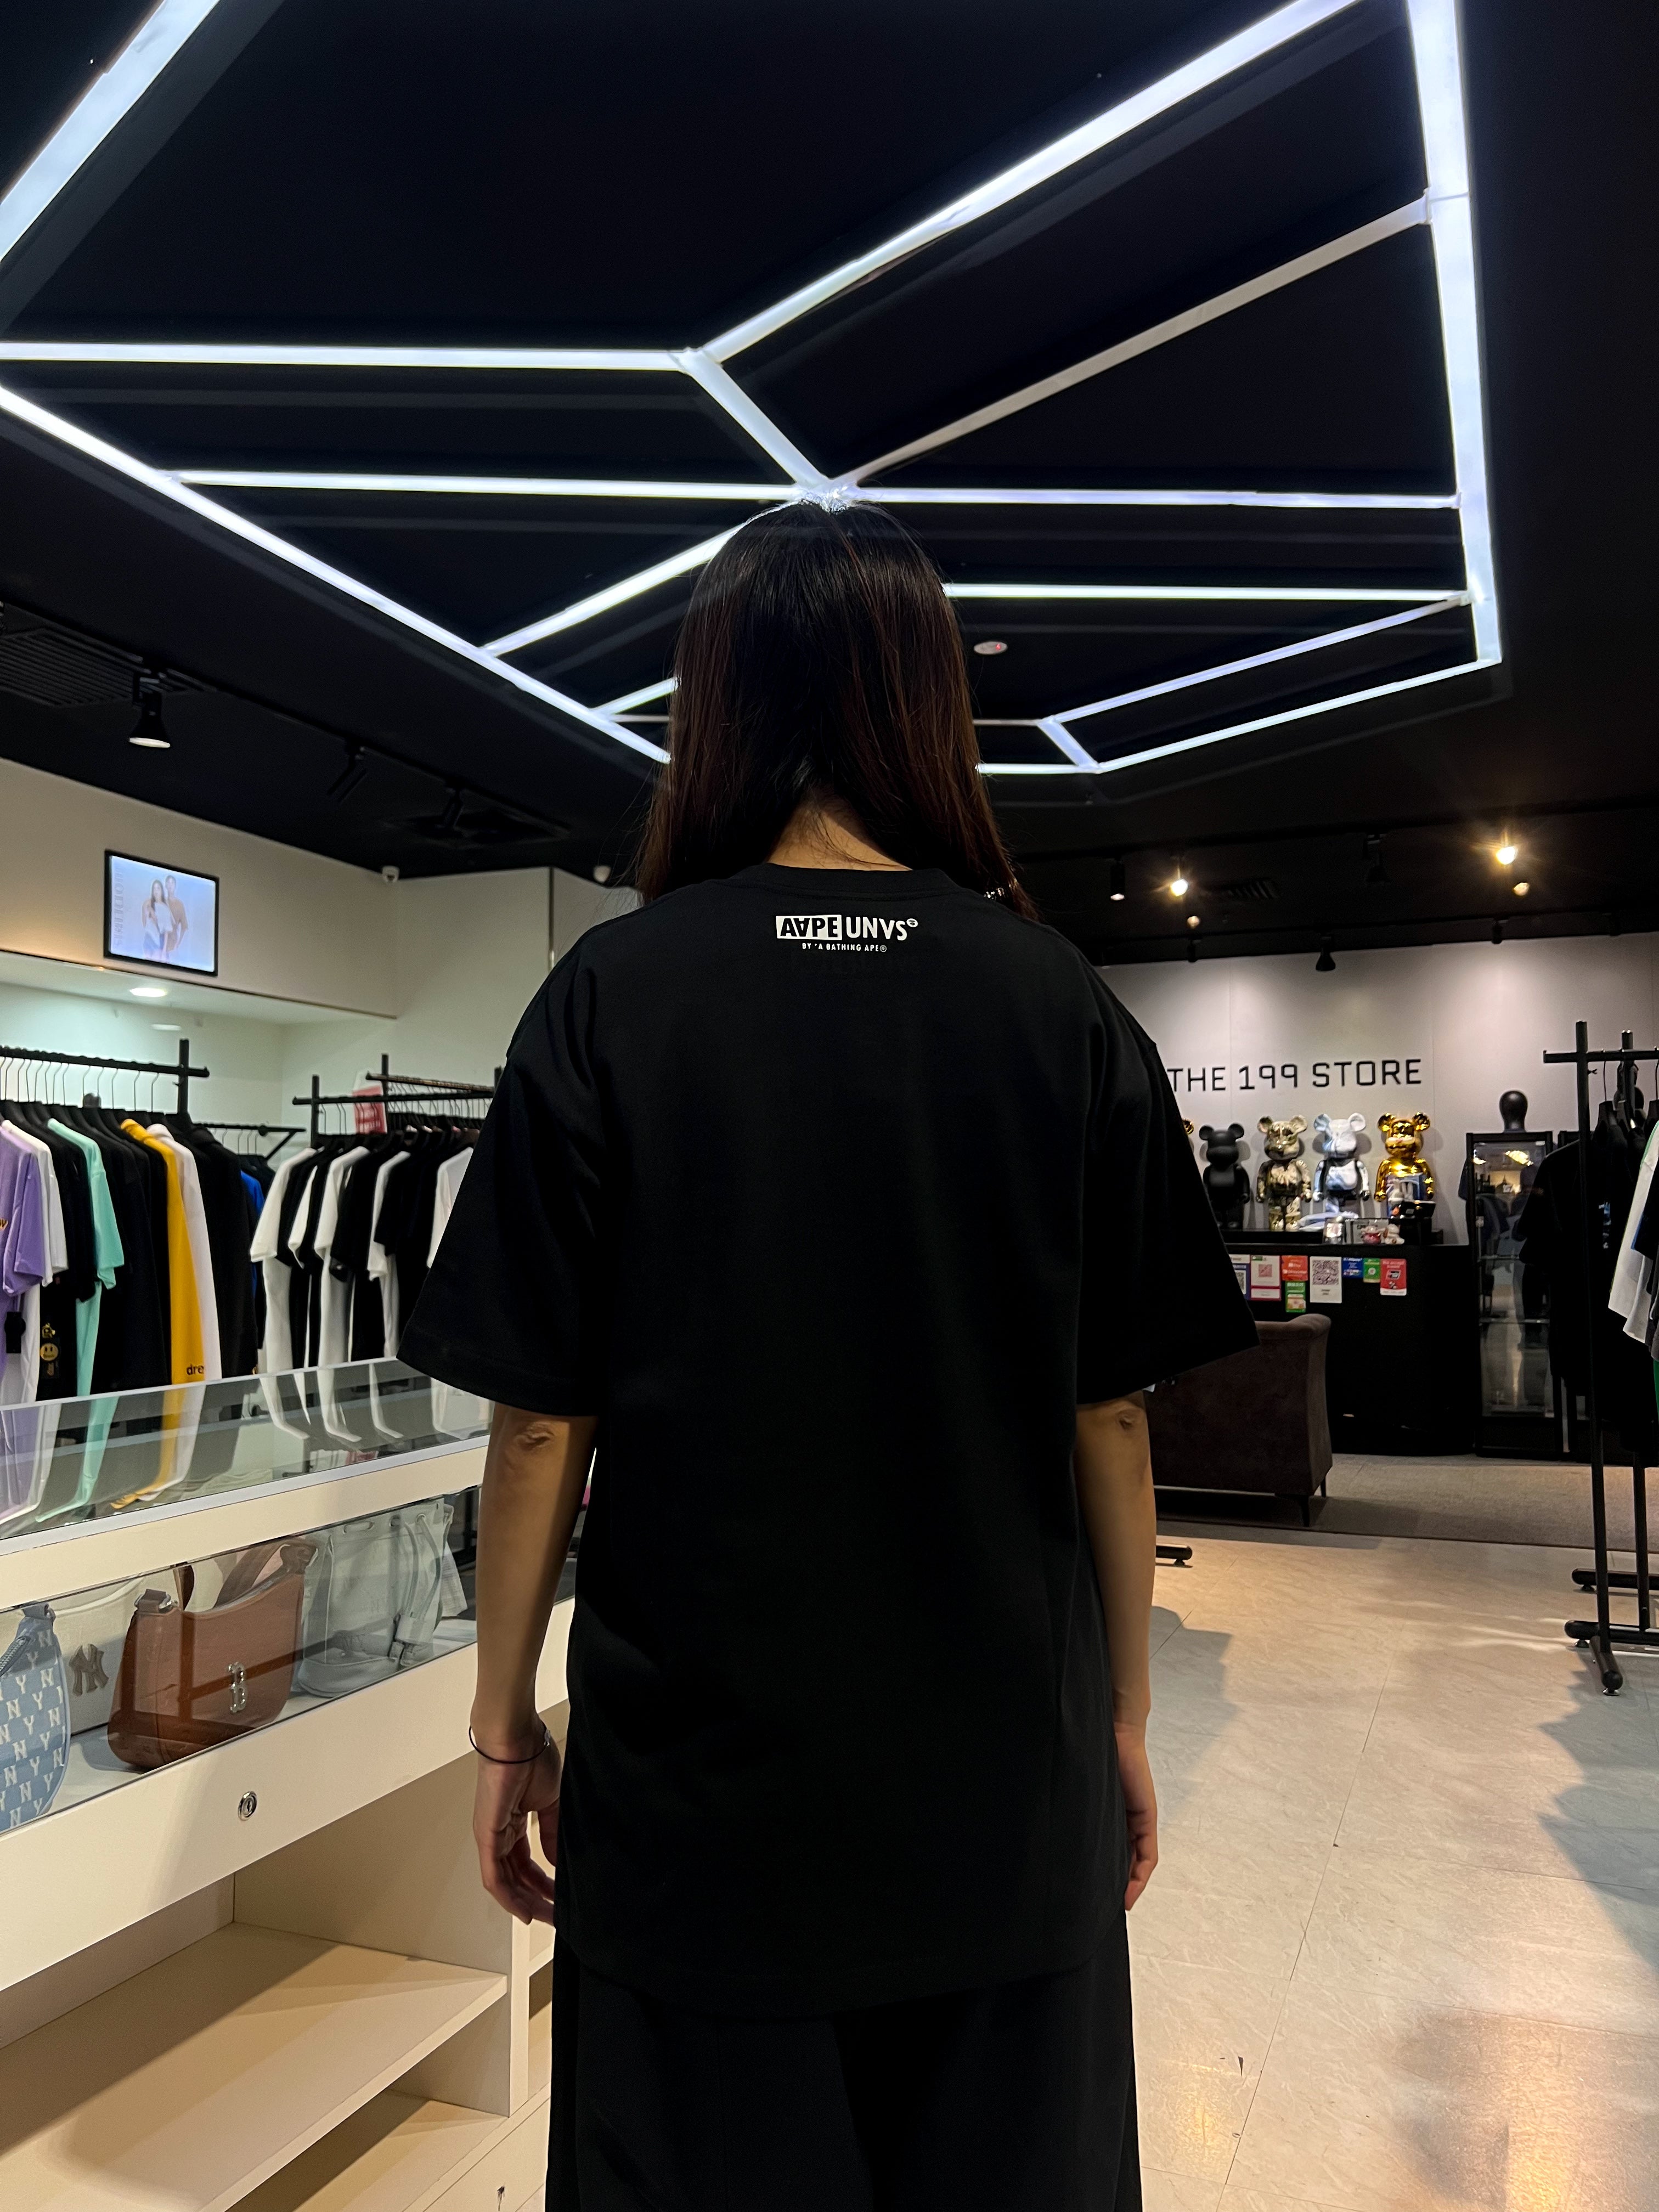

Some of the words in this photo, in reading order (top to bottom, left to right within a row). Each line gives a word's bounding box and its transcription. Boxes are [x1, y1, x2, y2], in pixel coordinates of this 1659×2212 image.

[846, 916, 907, 941] UNVS
[826, 943, 861, 951] BATHING
[1166, 1066, 1226, 1092] THE
[1238, 1063, 1299, 1091] 199
[1312, 1058, 1421, 1088] STORE
[15, 1674, 26, 1695] Y
[40, 1668, 54, 1688] N
[69, 1644, 109, 1697] NY
[6, 1698, 21, 1720] N
[32, 1691, 43, 1710] Y
[23, 1715, 35, 1735] Y
[48, 1707, 61, 1728] N
[13, 1740, 27, 1762] N
[40, 1731, 50, 1751] Y
[4, 1764, 18, 1787] N
[29, 1756, 40, 1776] Y
[19, 1781, 31, 1804] N
[43, 1771, 54, 1792] Y
